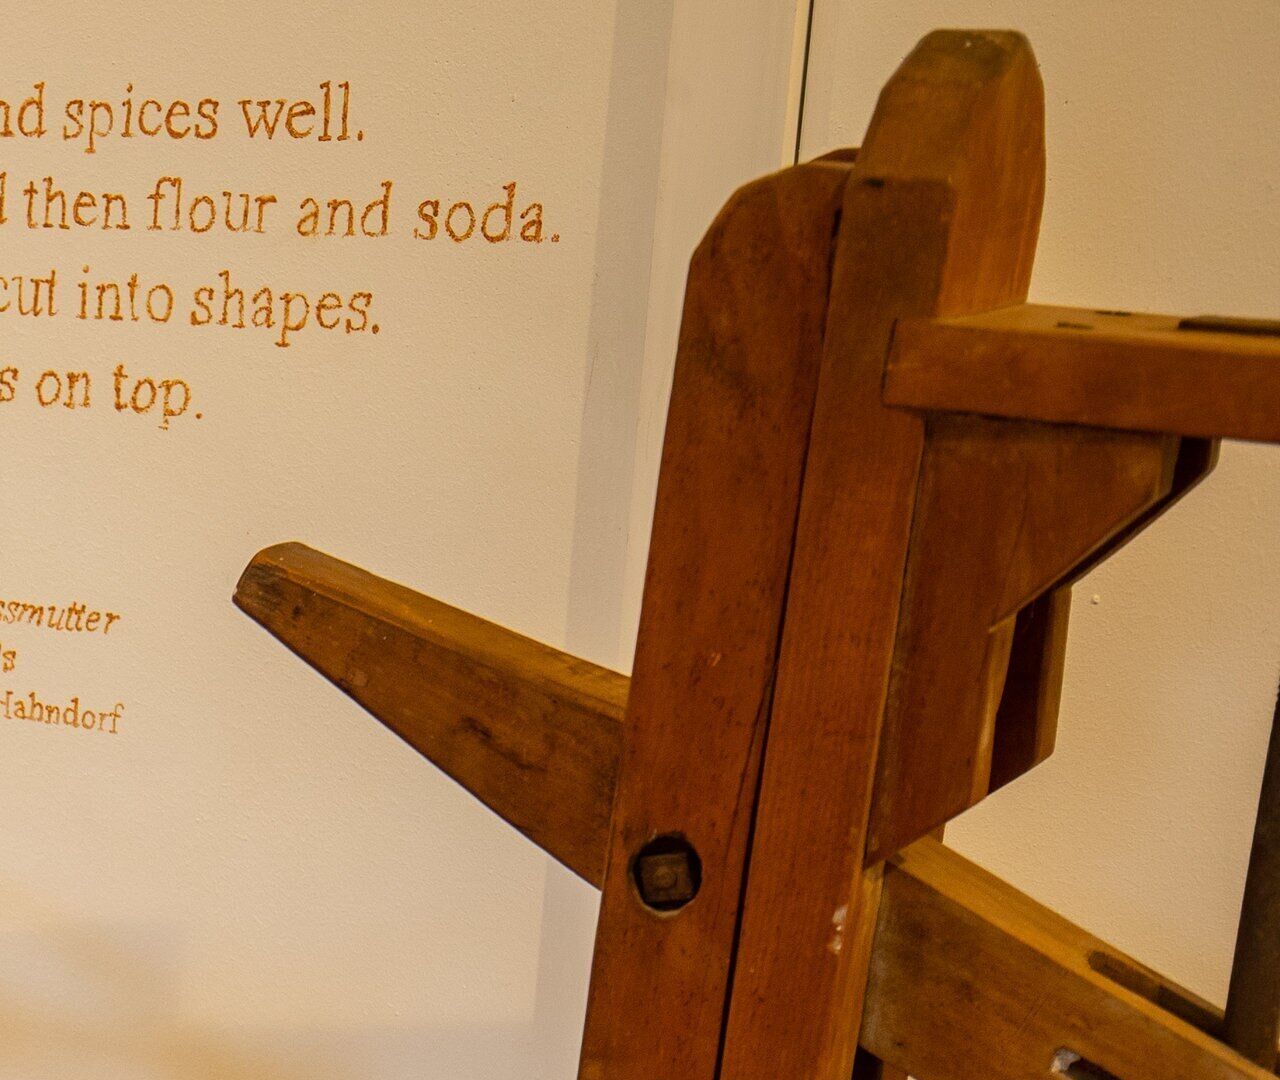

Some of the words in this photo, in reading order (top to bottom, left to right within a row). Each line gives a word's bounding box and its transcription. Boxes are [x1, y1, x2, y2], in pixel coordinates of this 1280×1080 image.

[62, 83, 220, 155] spices
[237, 80, 365, 142] well.
[22, 175, 132, 231] then
[146, 175, 278, 234] flour
[295, 179, 394, 239] and
[413, 181, 560, 244] soda.
[76, 264, 176, 324] into
[189, 269, 381, 348] shapes.
[34, 368, 92, 410] on
[111, 362, 203, 431] top.
